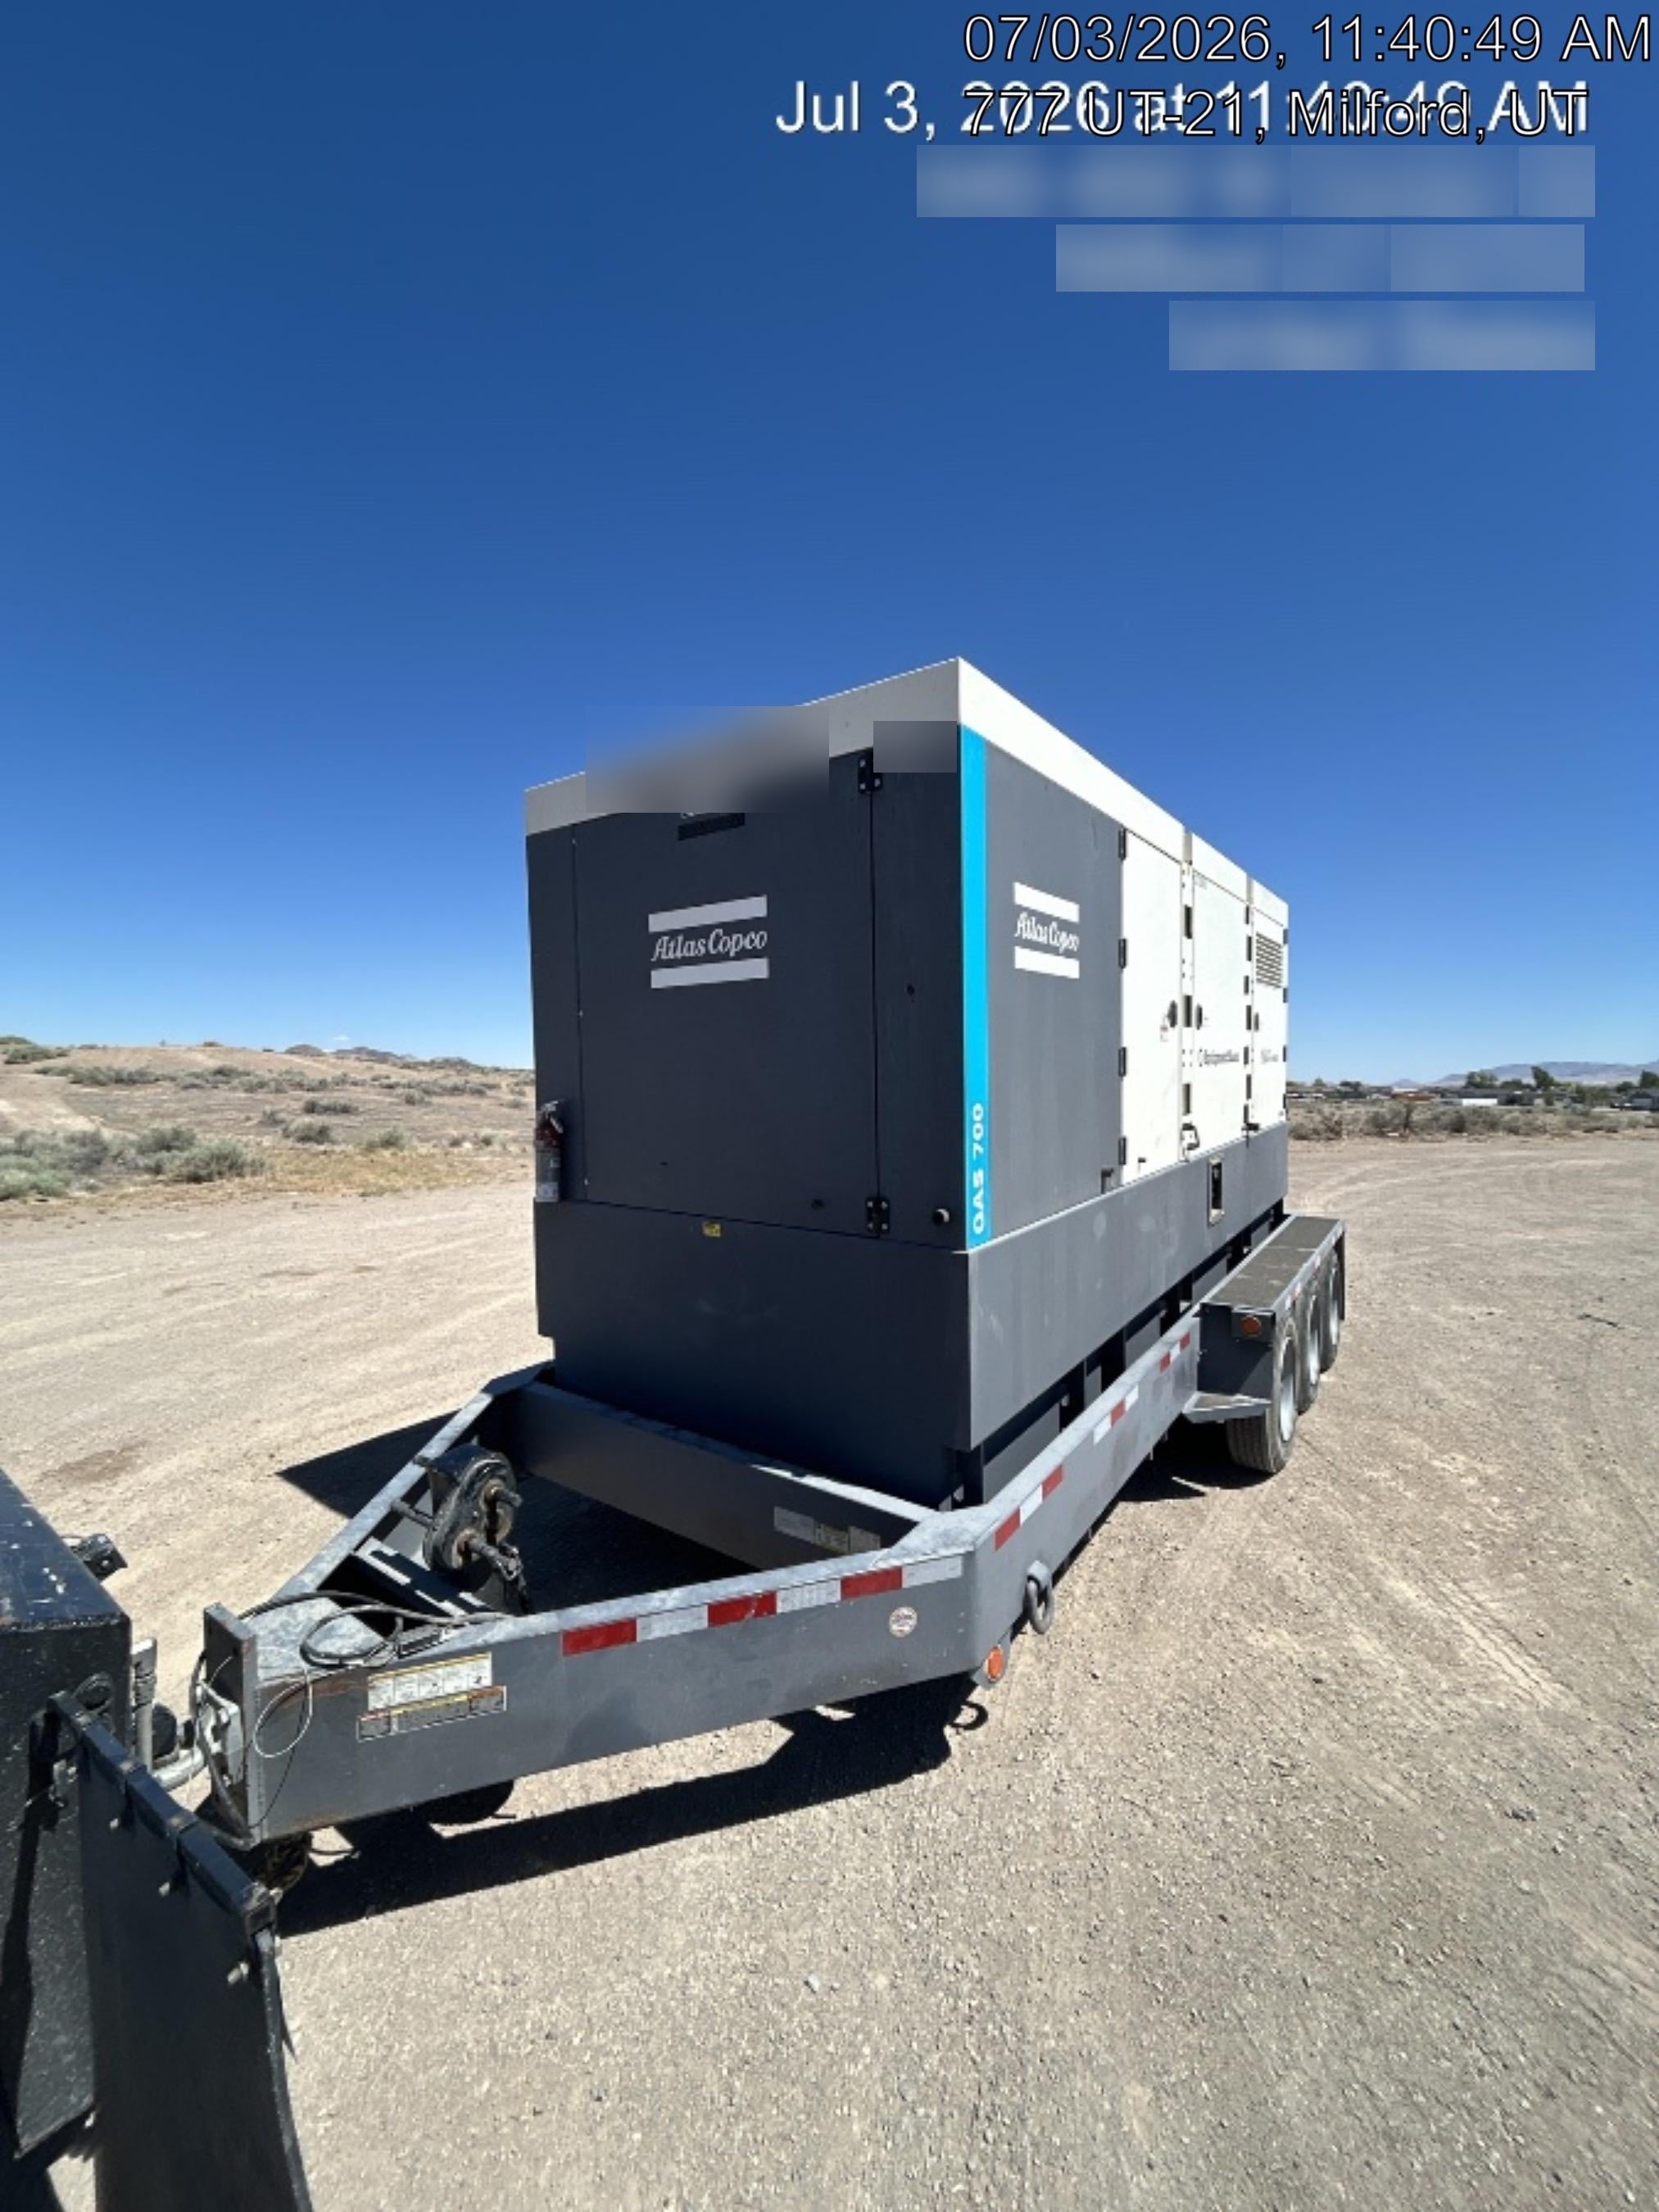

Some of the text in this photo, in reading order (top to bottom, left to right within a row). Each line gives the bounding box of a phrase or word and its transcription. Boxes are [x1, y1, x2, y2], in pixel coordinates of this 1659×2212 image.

[651, 928, 768, 962] Atlas Copco
[1014, 911, 1048, 945] Atlas
[972, 1103, 984, 1161] 700
